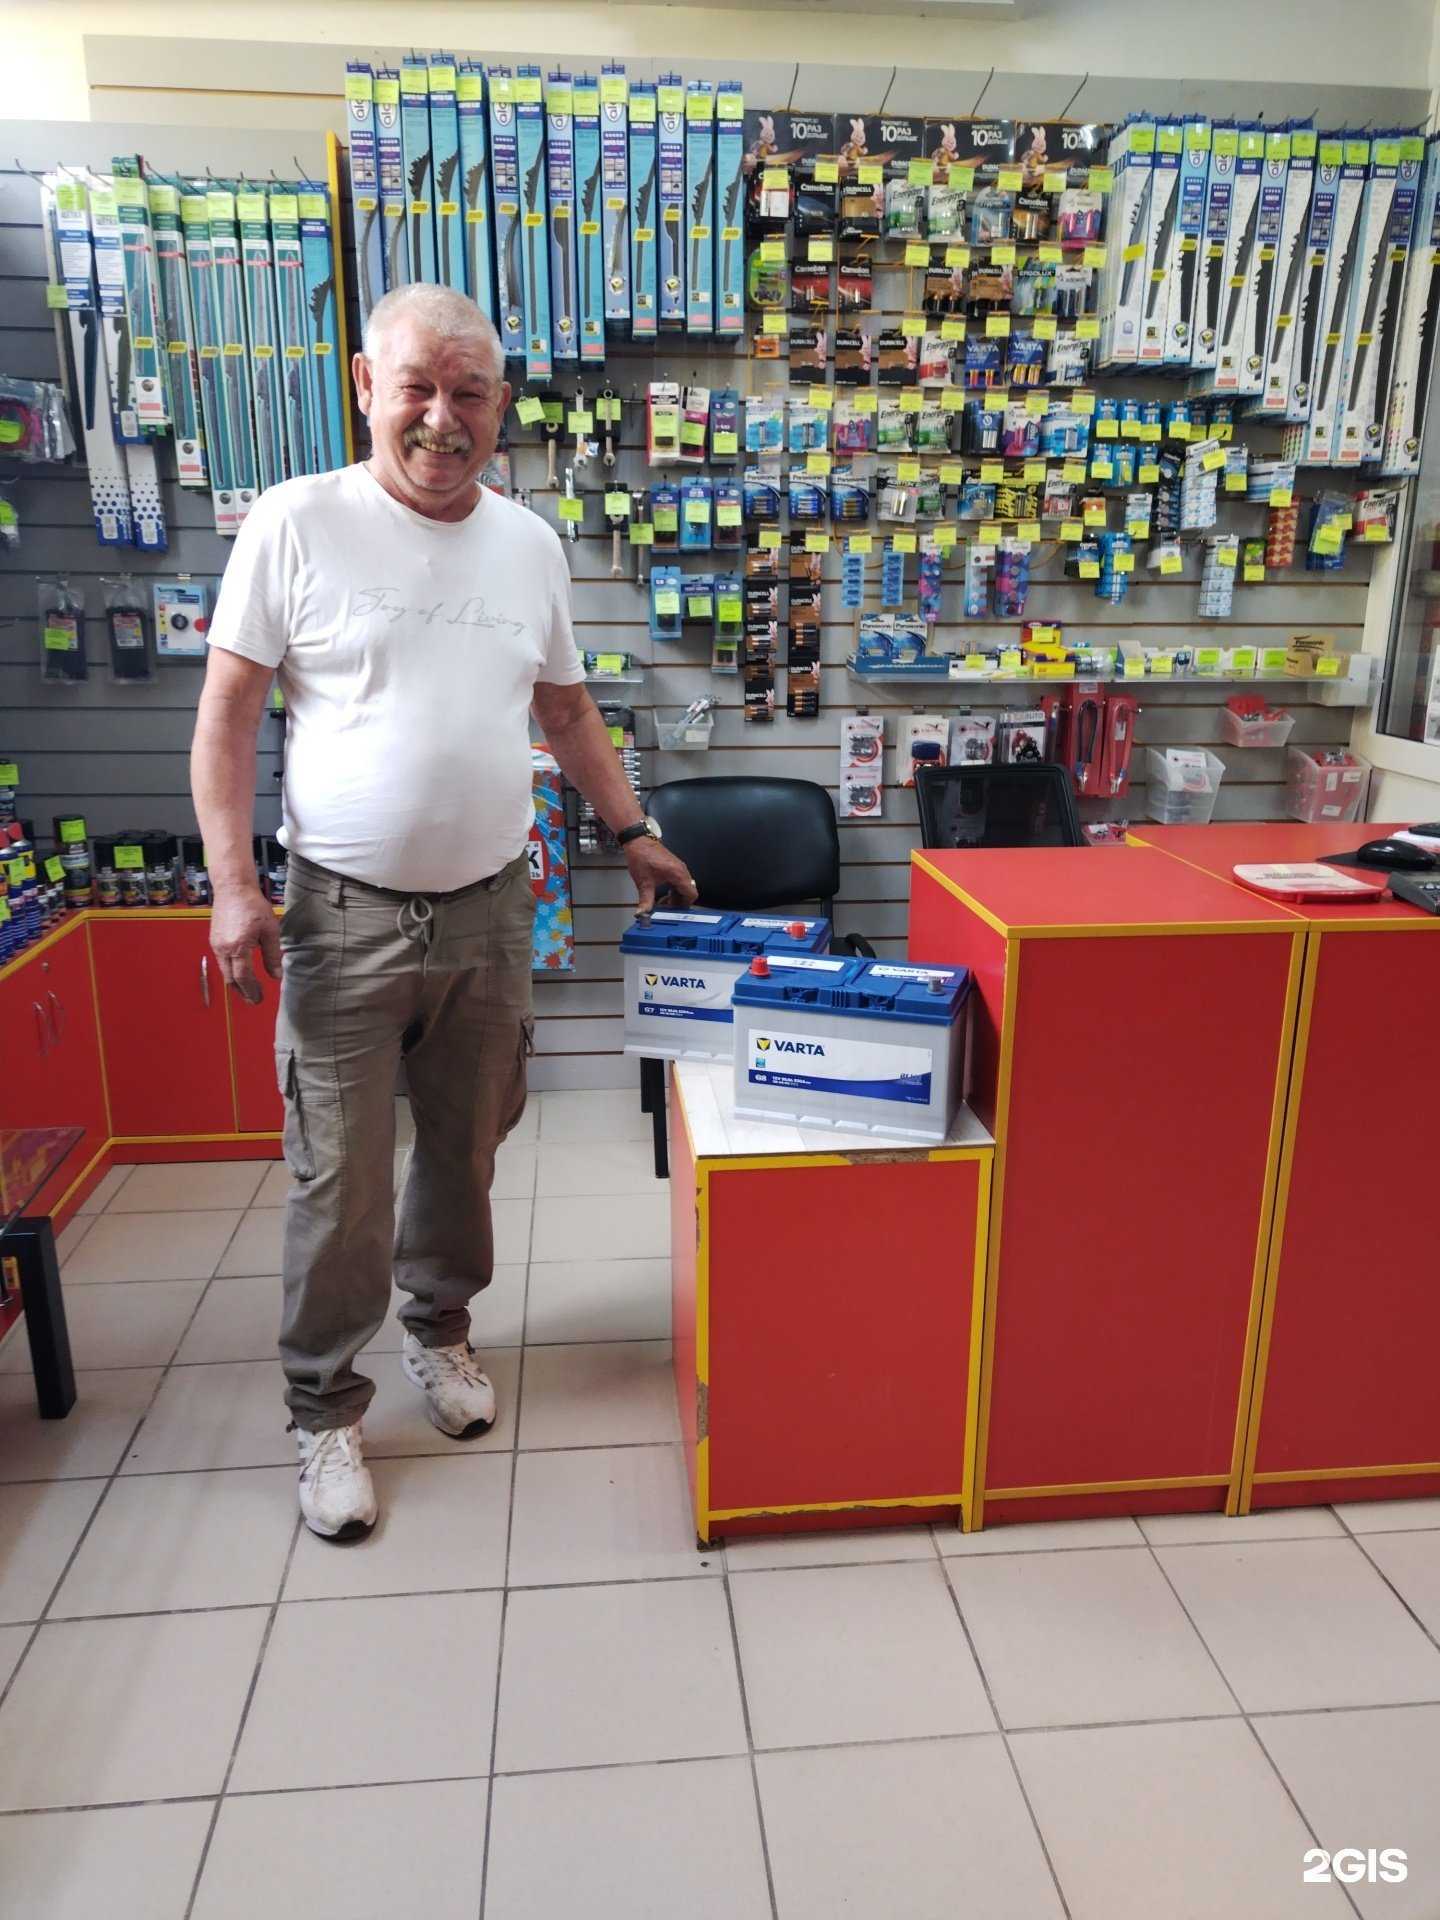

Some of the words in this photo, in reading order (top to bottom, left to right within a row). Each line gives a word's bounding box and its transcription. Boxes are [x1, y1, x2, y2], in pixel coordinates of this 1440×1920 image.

[790, 123, 807, 139] 10
[880, 125, 897, 142] 10
[971, 130, 988, 146] 10
[1062, 133, 1078, 149] 10
[967, 344, 999, 352] VARTA
[1013, 342, 1043, 351] VARTA
[415, 602, 443, 624] of
[446, 597, 527, 636] Living
[661, 975, 706, 990] VARTA
[774, 1040, 825, 1056] VARTA
